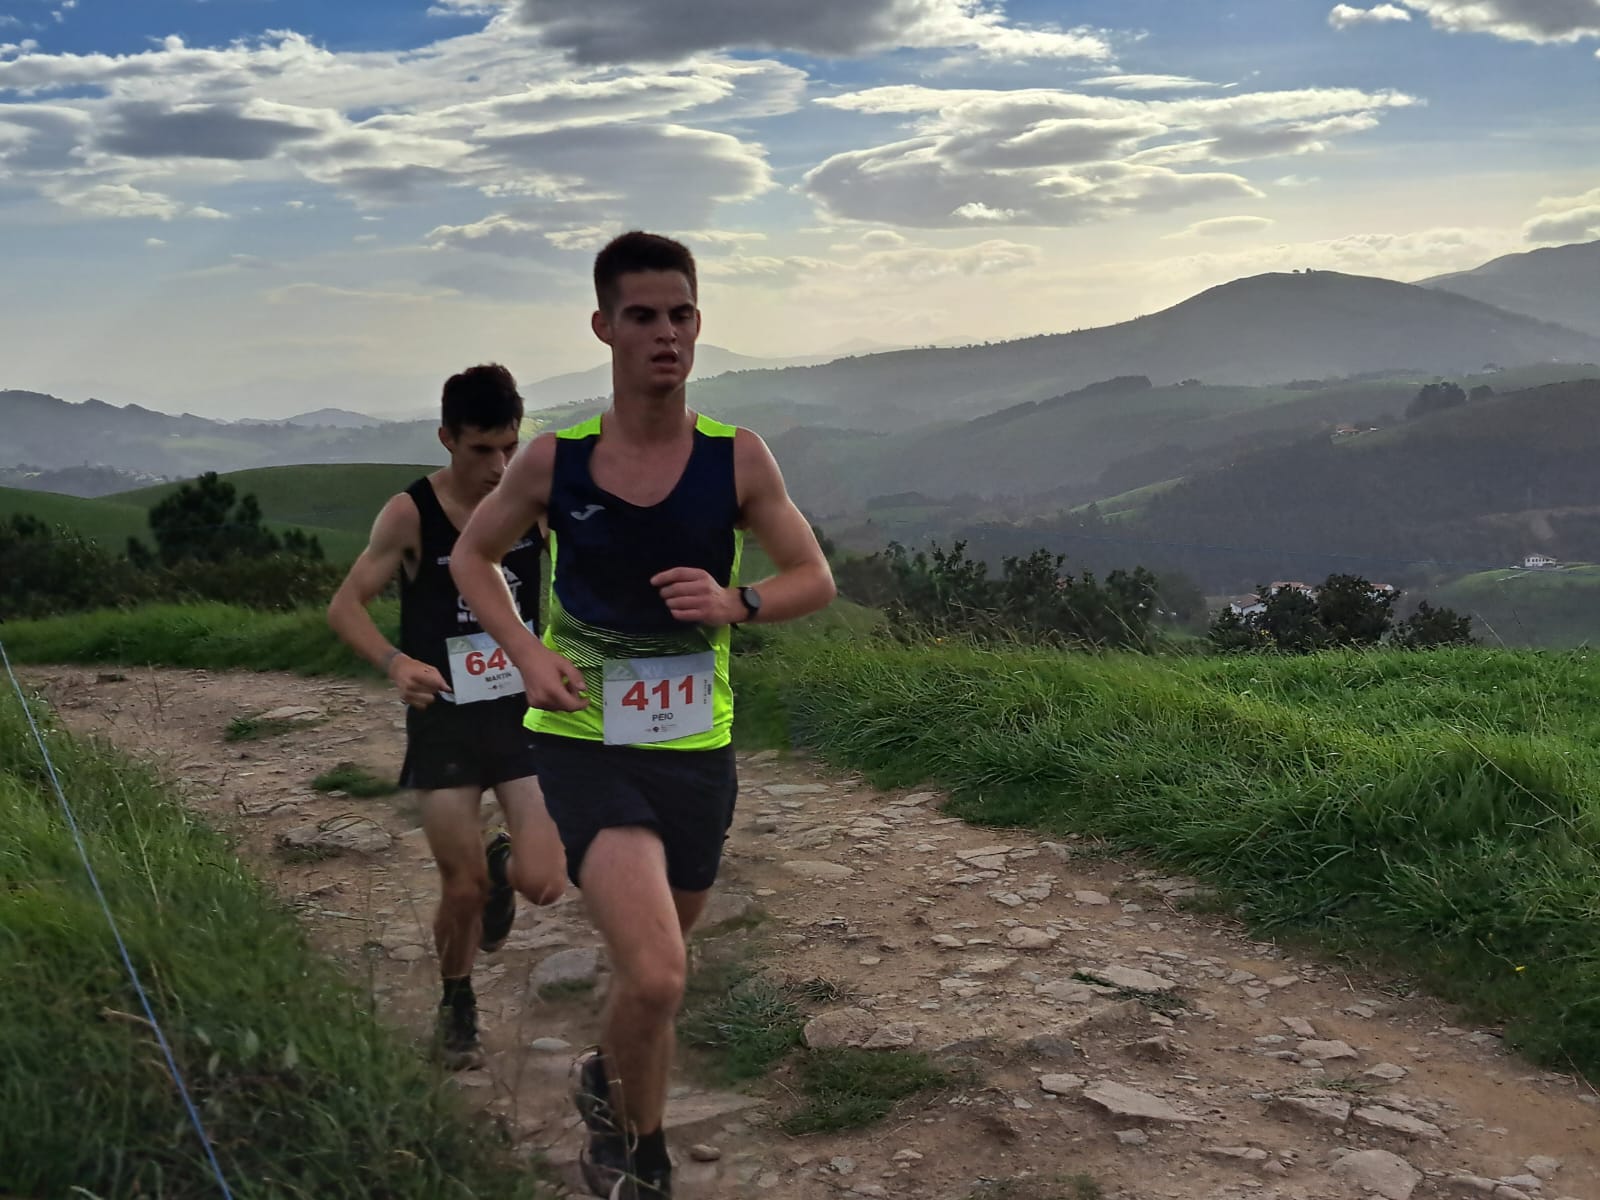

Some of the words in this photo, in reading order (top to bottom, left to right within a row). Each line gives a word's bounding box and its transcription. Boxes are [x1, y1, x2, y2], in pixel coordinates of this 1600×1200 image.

[465, 648, 518, 676] 64
[622, 675, 694, 711] 411
[652, 712, 674, 721] PEIO
